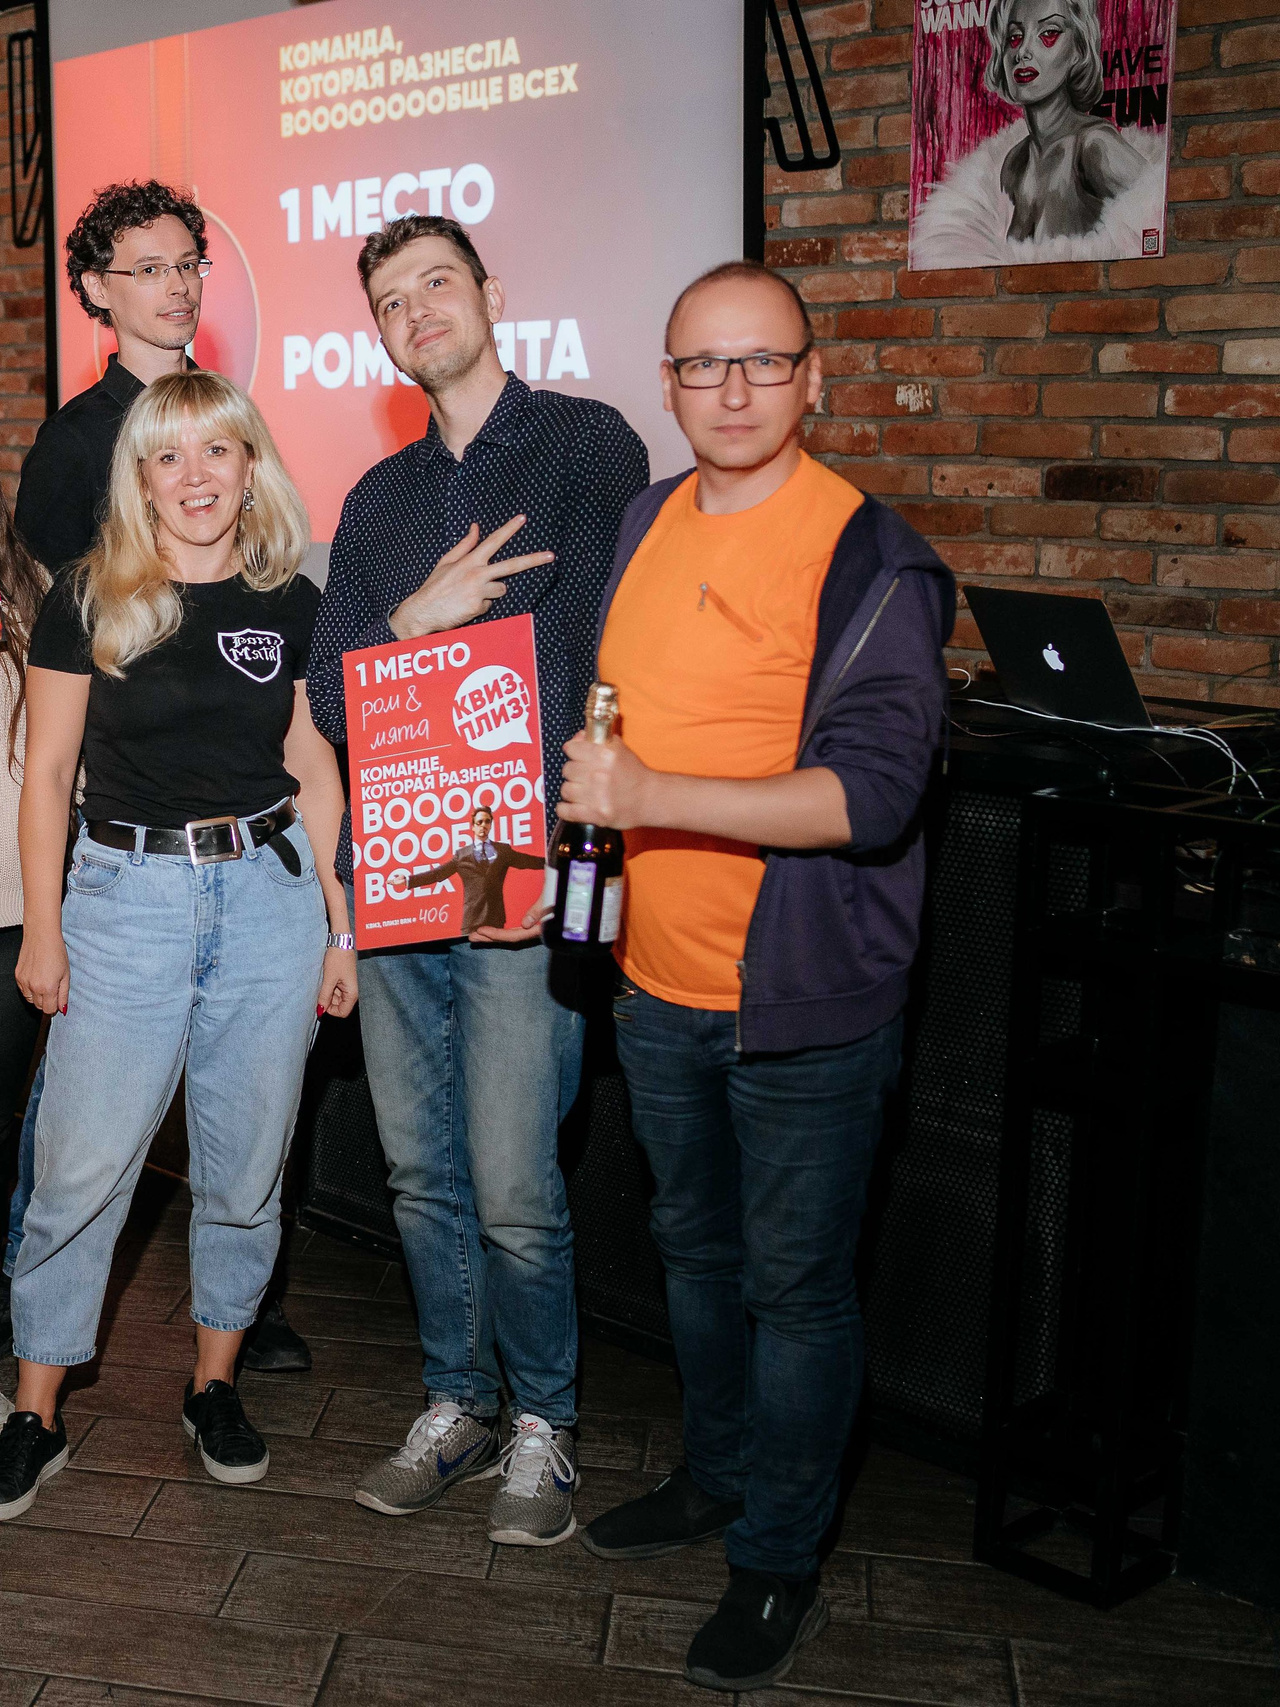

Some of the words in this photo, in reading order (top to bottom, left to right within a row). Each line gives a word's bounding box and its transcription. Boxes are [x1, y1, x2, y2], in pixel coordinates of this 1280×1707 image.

[279, 25, 404, 71] КОМАНДА,
[280, 59, 385, 104] КОТОРАЯ
[390, 37, 520, 85] РАЗНЕСЛА
[281, 76, 503, 137] ВООООООООБЩЕ
[508, 63, 578, 102] ВСЕХ
[279, 188, 300, 244] 1
[312, 163, 495, 241] МЕСТО
[355, 663, 367, 687] 1
[374, 641, 471, 684] МЕСТО
[361, 693, 401, 731] ром
[405, 684, 422, 712] &
[370, 718, 430, 750] мята
[360, 756, 444, 783] КОМАНДЕ,
[361, 774, 435, 802] КОТОРАЯ
[439, 759, 527, 788] РАЗНЕСЛА
[419, 904, 450, 924] 406
